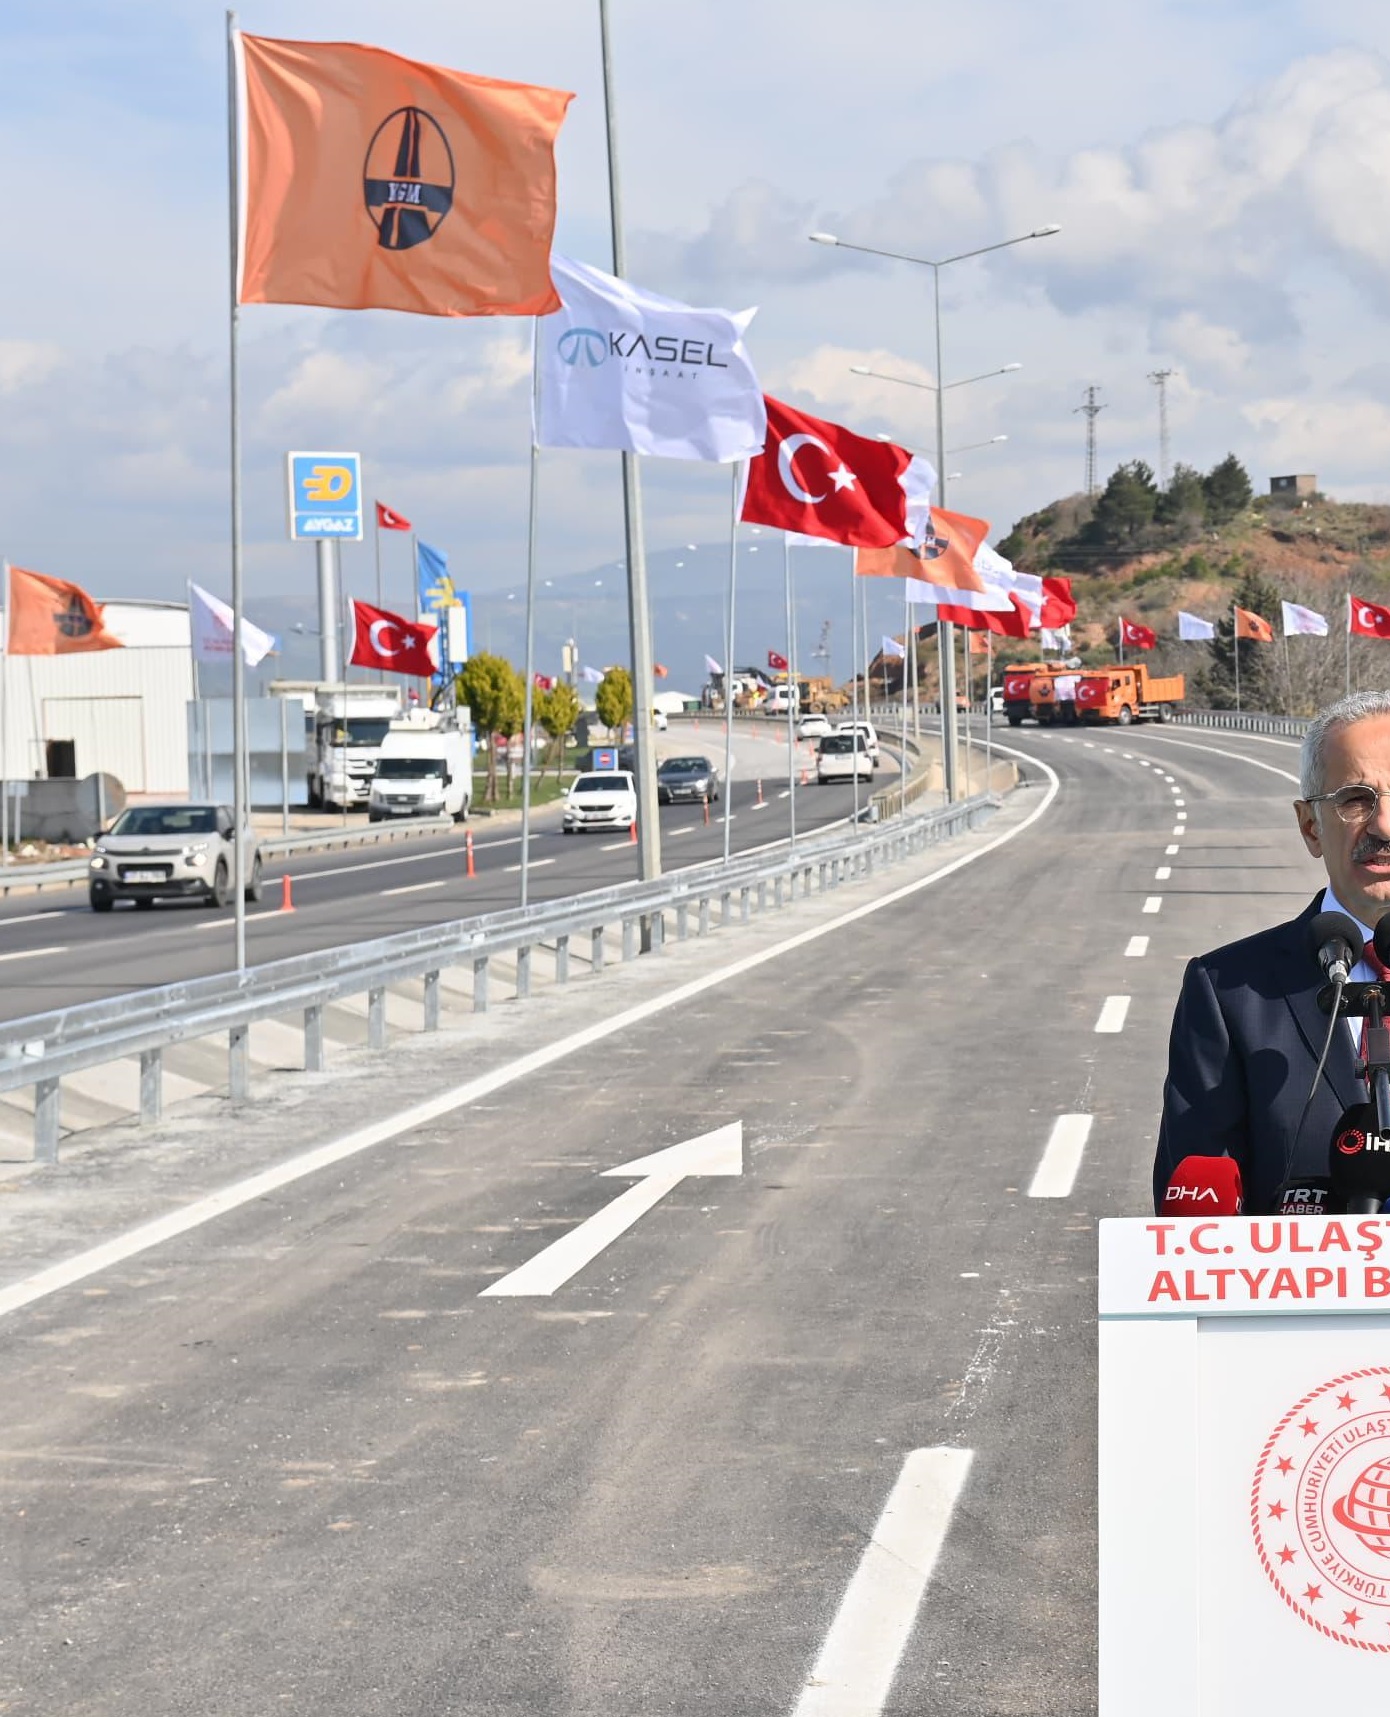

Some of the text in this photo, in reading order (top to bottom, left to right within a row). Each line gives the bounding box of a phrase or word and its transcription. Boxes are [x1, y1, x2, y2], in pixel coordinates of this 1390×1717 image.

[609, 331, 728, 368] KASEL
[303, 517, 355, 532] AYGAZ
[1165, 1186, 1219, 1203] DHA
[1282, 1188, 1328, 1204] TRT
[1146, 1222, 1234, 1257] T.C.
[1147, 1265, 1347, 1302] ALTYAPI
[1303, 1436, 1345, 1553] CUMHURİYETİ
[1320, 1552, 1388, 1599] TÜRKİYE
